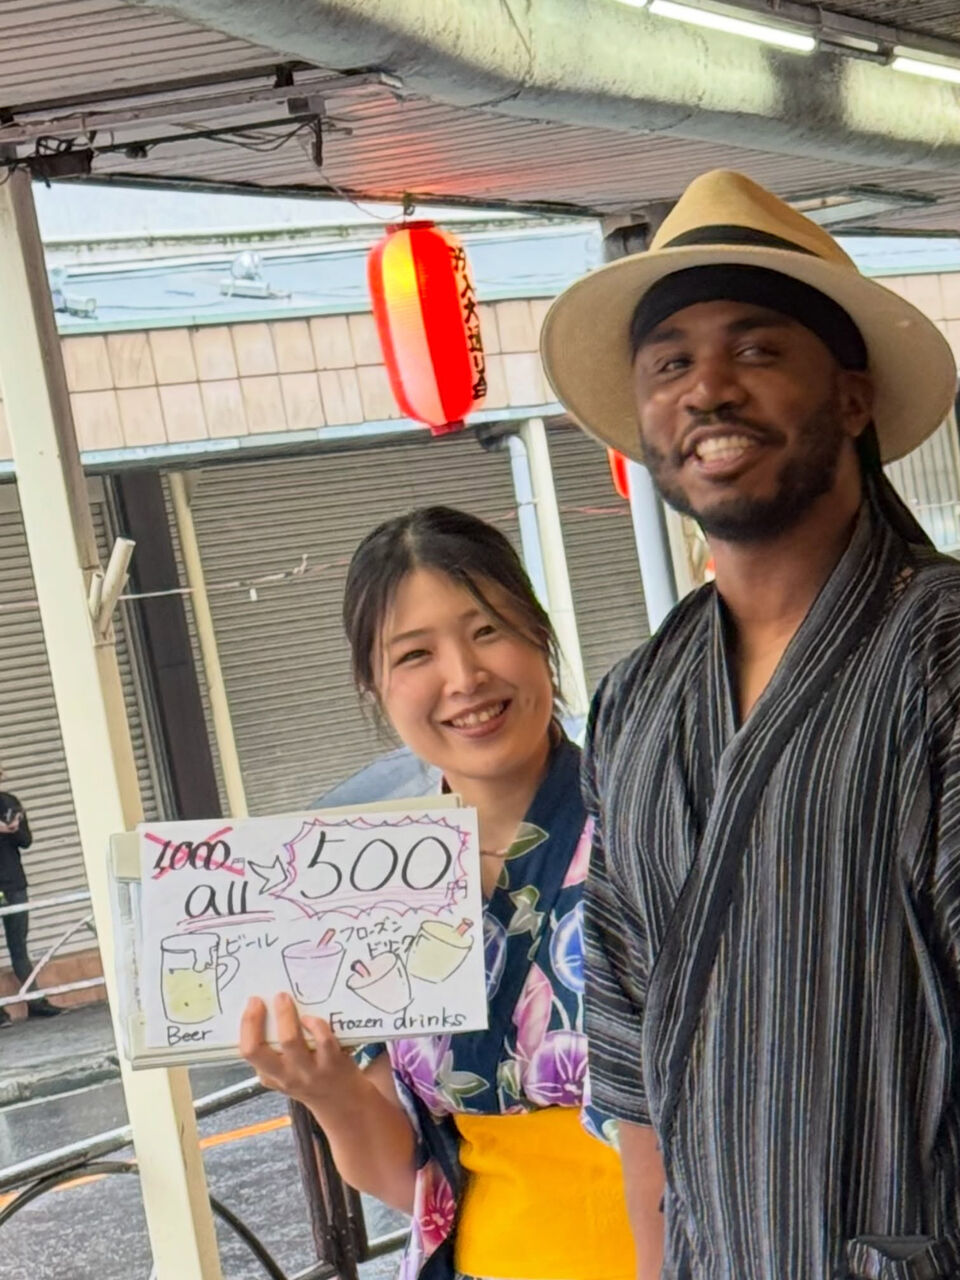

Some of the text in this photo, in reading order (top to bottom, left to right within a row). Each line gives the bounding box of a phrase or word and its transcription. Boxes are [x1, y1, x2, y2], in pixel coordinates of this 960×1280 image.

[184, 880, 249, 919] all
[339, 916, 403, 943] フローズン
[225, 932, 280, 956] ビール
[329, 1006, 468, 1034] Frozen drinks
[167, 1025, 214, 1047] Beer
